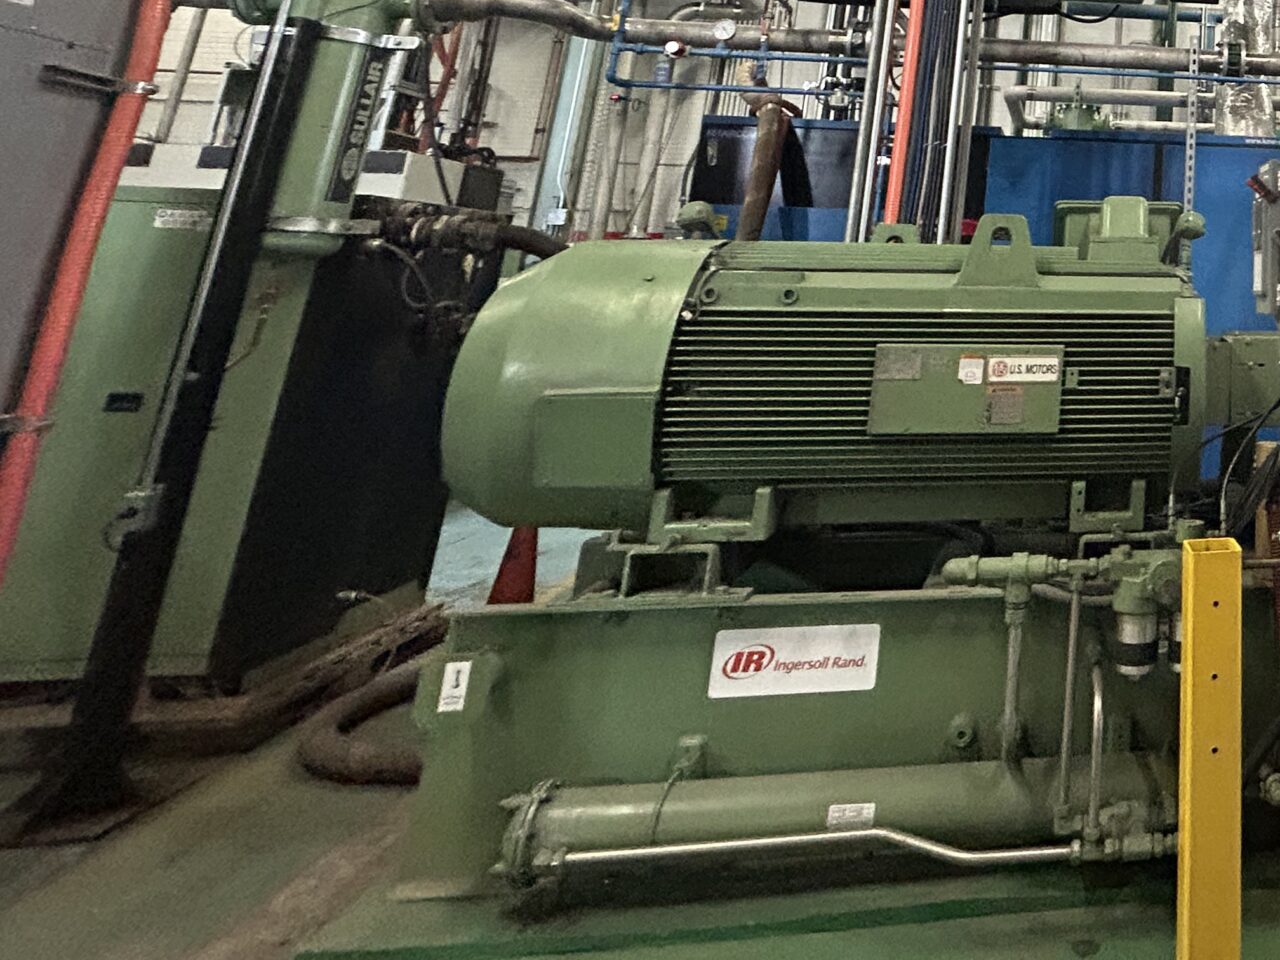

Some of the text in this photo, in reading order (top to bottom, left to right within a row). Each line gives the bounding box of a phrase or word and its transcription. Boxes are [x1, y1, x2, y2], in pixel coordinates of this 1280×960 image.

[350, 60, 384, 145] SULLAIR
[1025, 363, 1058, 375] MOTORS
[730, 650, 766, 673] IR
[773, 656, 830, 674] Ingersoll
